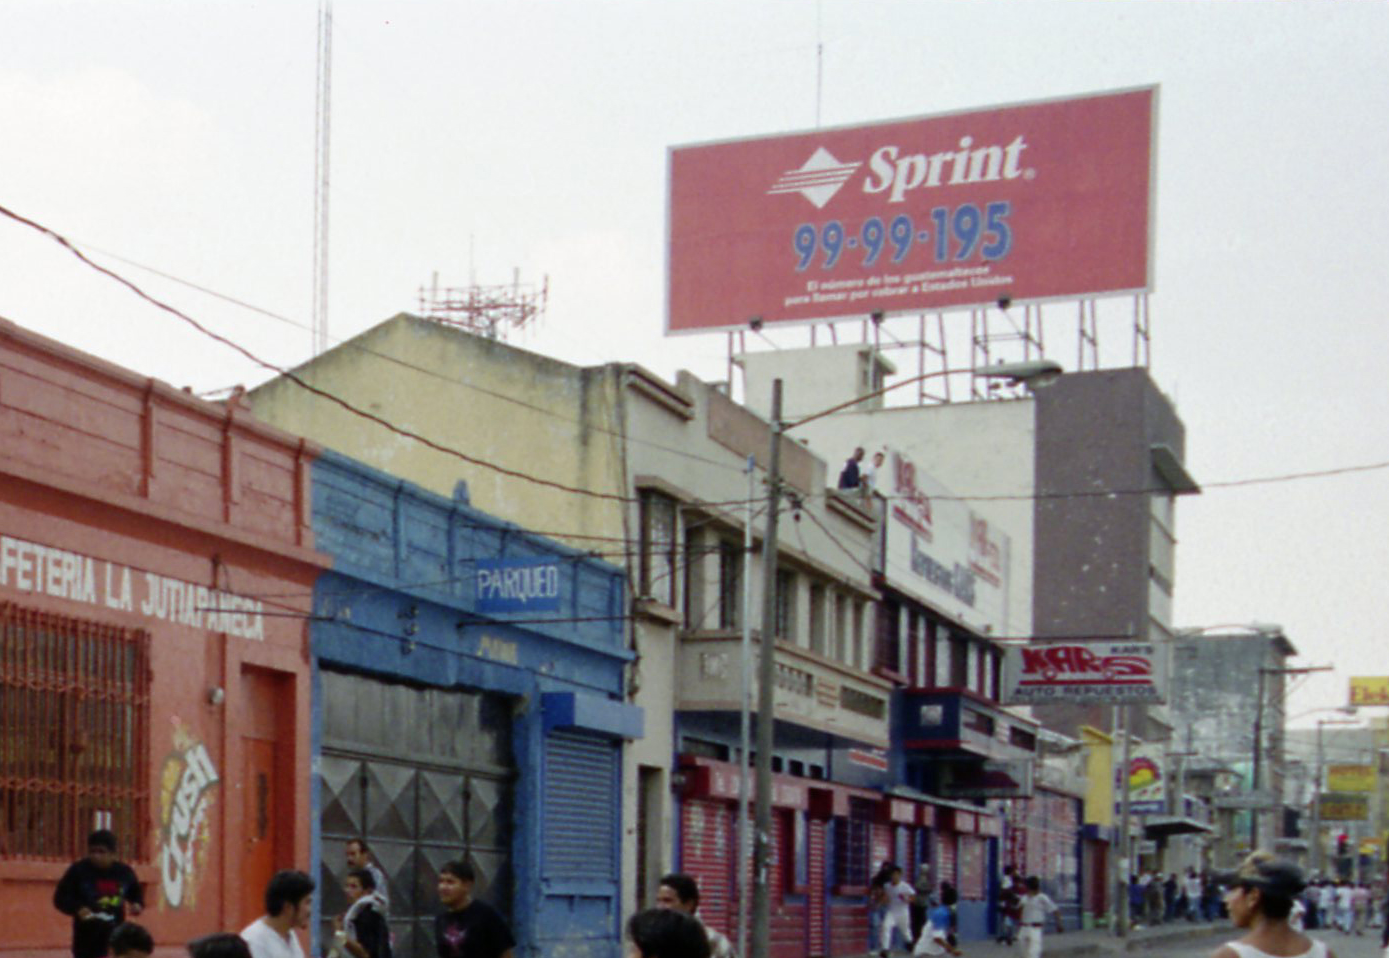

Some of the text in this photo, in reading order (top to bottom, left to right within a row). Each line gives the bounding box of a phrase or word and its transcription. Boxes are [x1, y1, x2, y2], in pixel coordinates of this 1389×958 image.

[862, 135, 1028, 203] Sprint
[794, 201, 1012, 272] 99-99-195
[105, 562, 133, 612] LA
[141, 572, 264, 641] JUTIAPANECA
[1014, 685, 1157, 697] AUTO REPUESTOS
[162, 743, 219, 908] Crush
